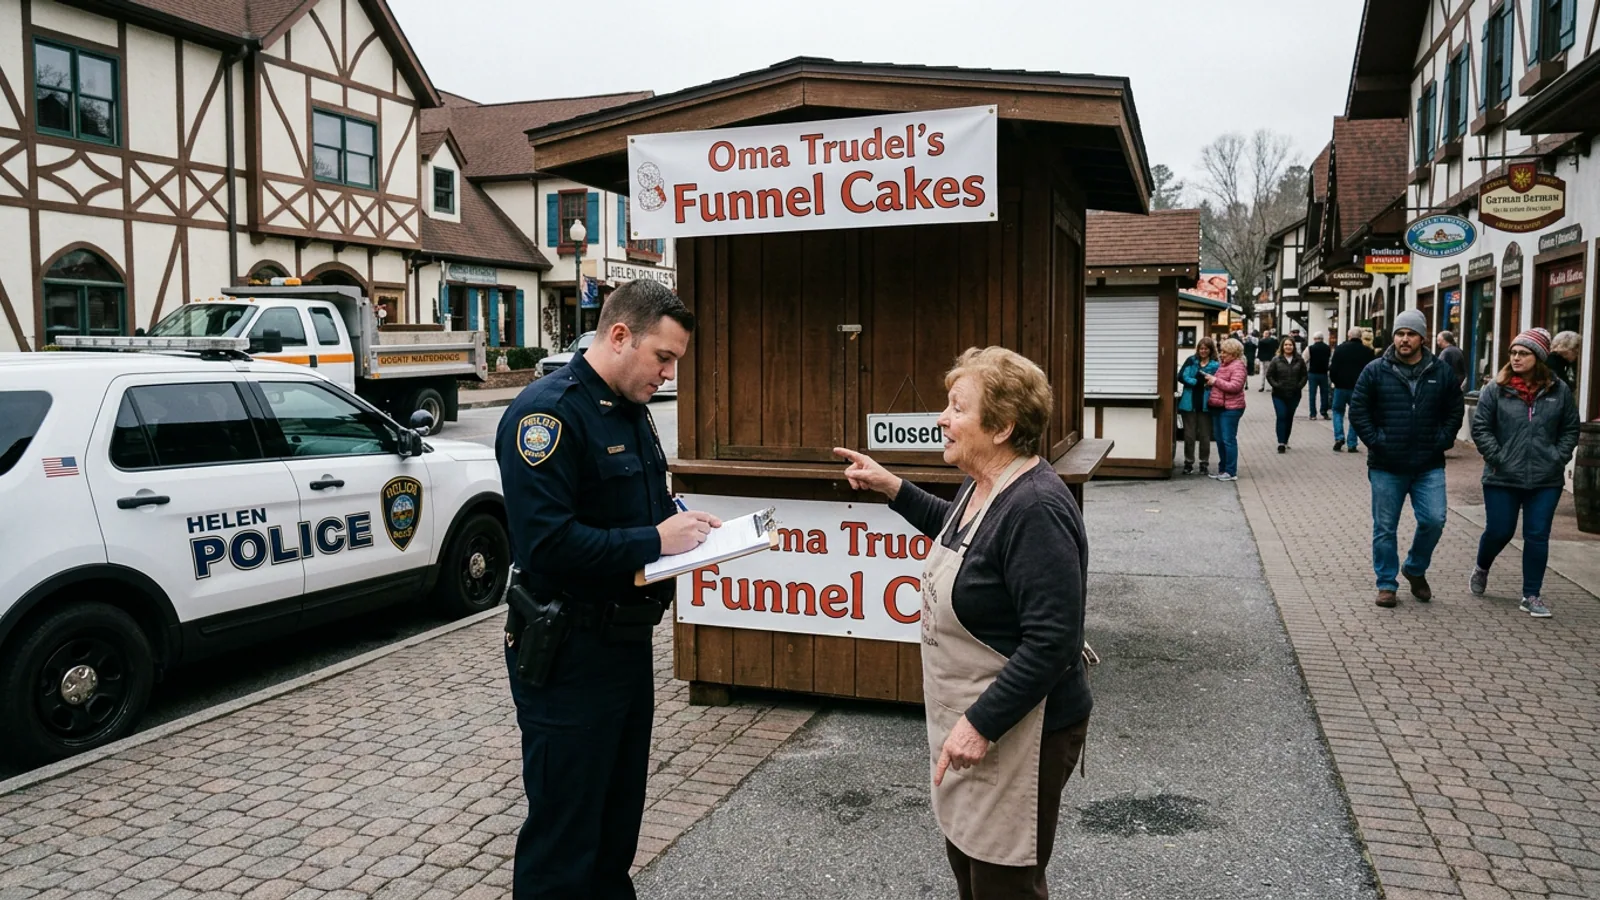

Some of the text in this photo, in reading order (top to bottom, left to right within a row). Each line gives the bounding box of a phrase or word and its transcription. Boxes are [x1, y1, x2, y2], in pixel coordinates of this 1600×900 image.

[708, 124, 945, 173] Oma Trudel's
[673, 166, 986, 224] Funnel Cakes
[874, 422, 943, 443] Closed
[187, 507, 267, 534] HELEN
[770, 527, 829, 554] ma
[190, 511, 374, 581] POLICE
[691, 563, 865, 620] Funnel
